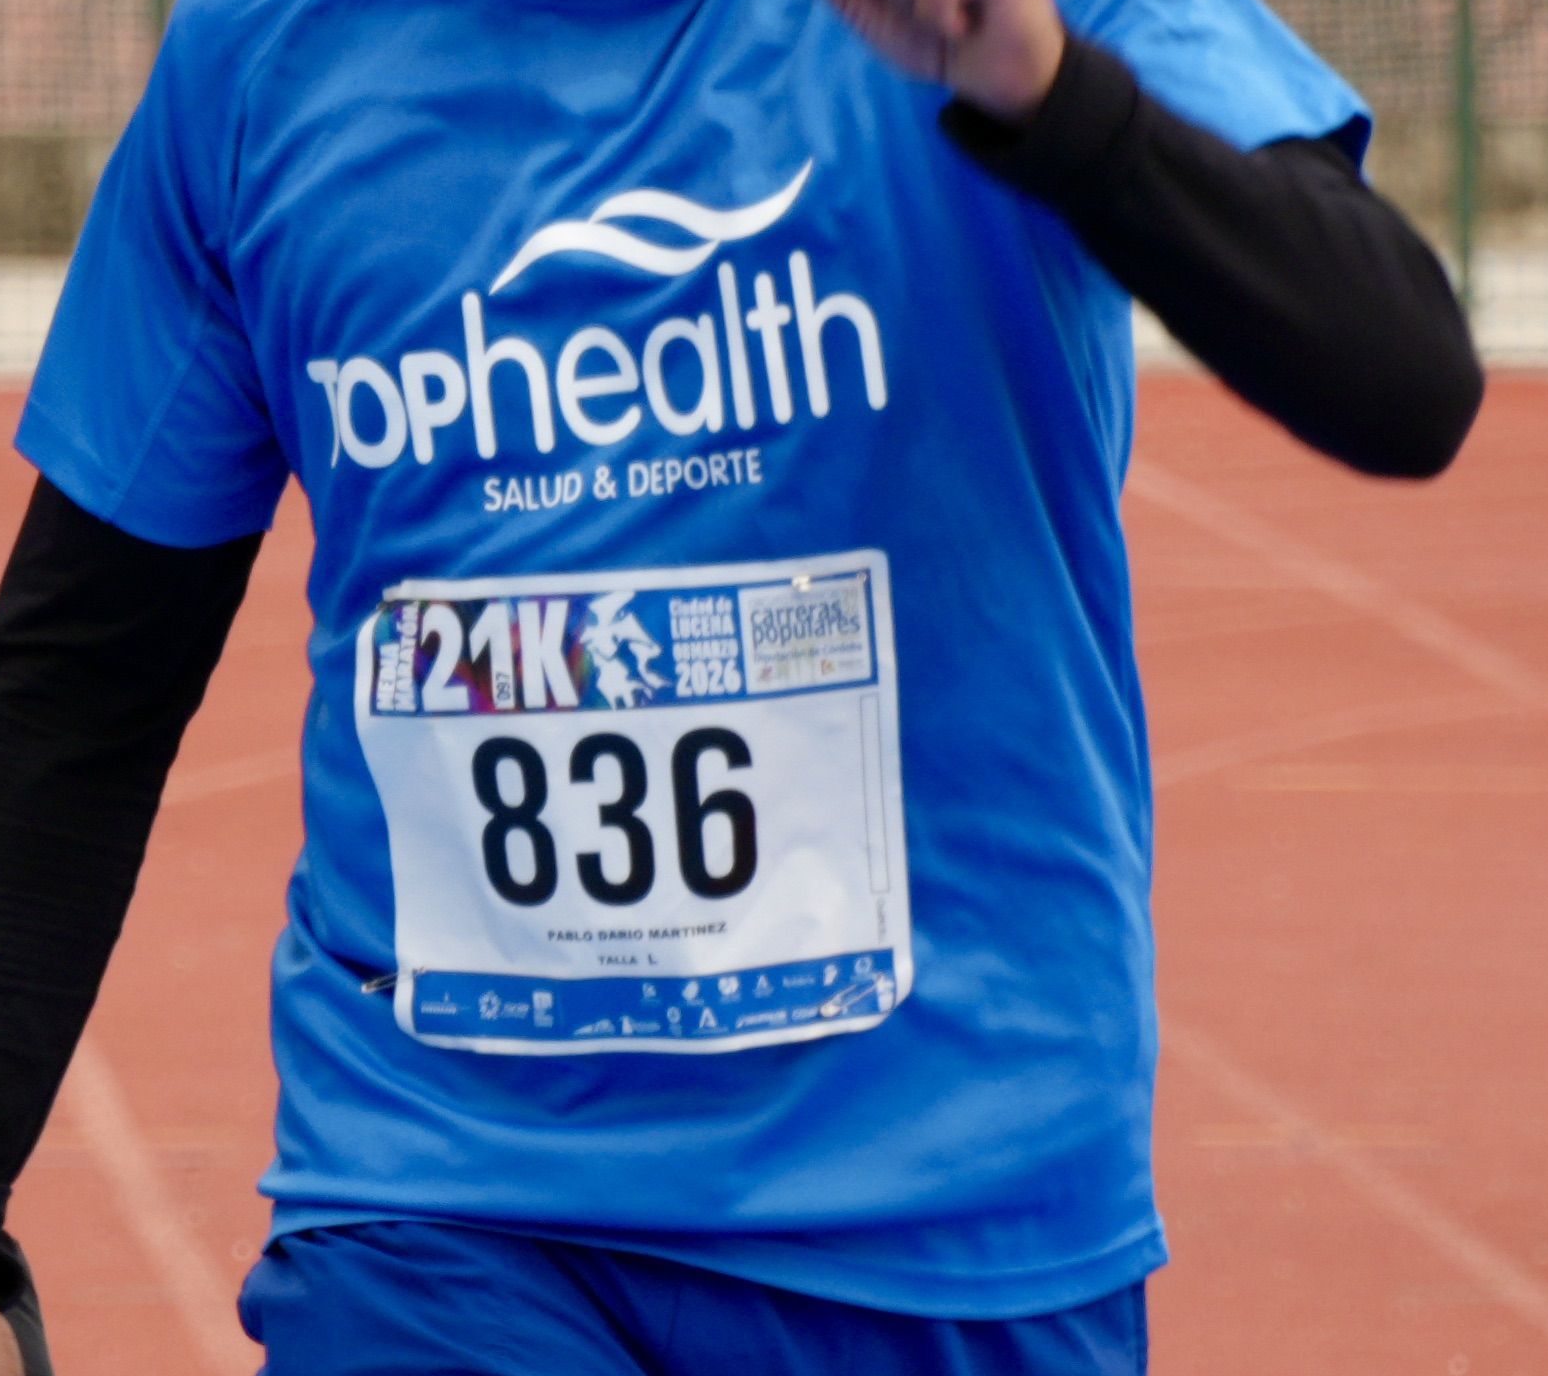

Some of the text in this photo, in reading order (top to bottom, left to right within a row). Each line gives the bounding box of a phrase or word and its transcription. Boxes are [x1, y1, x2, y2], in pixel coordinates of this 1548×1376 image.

[482, 447, 764, 512] SALUD & DEPORTE
[750, 600, 842, 625] carreras
[751, 611, 861, 650] populares
[421, 600, 579, 711] 21K
[675, 658, 742, 697] 2026
[472, 726, 759, 907] 836
[547, 929, 593, 942] PABLO
[648, 921, 728, 940] MARTINEZ
[598, 953, 658, 966] TALLA L
